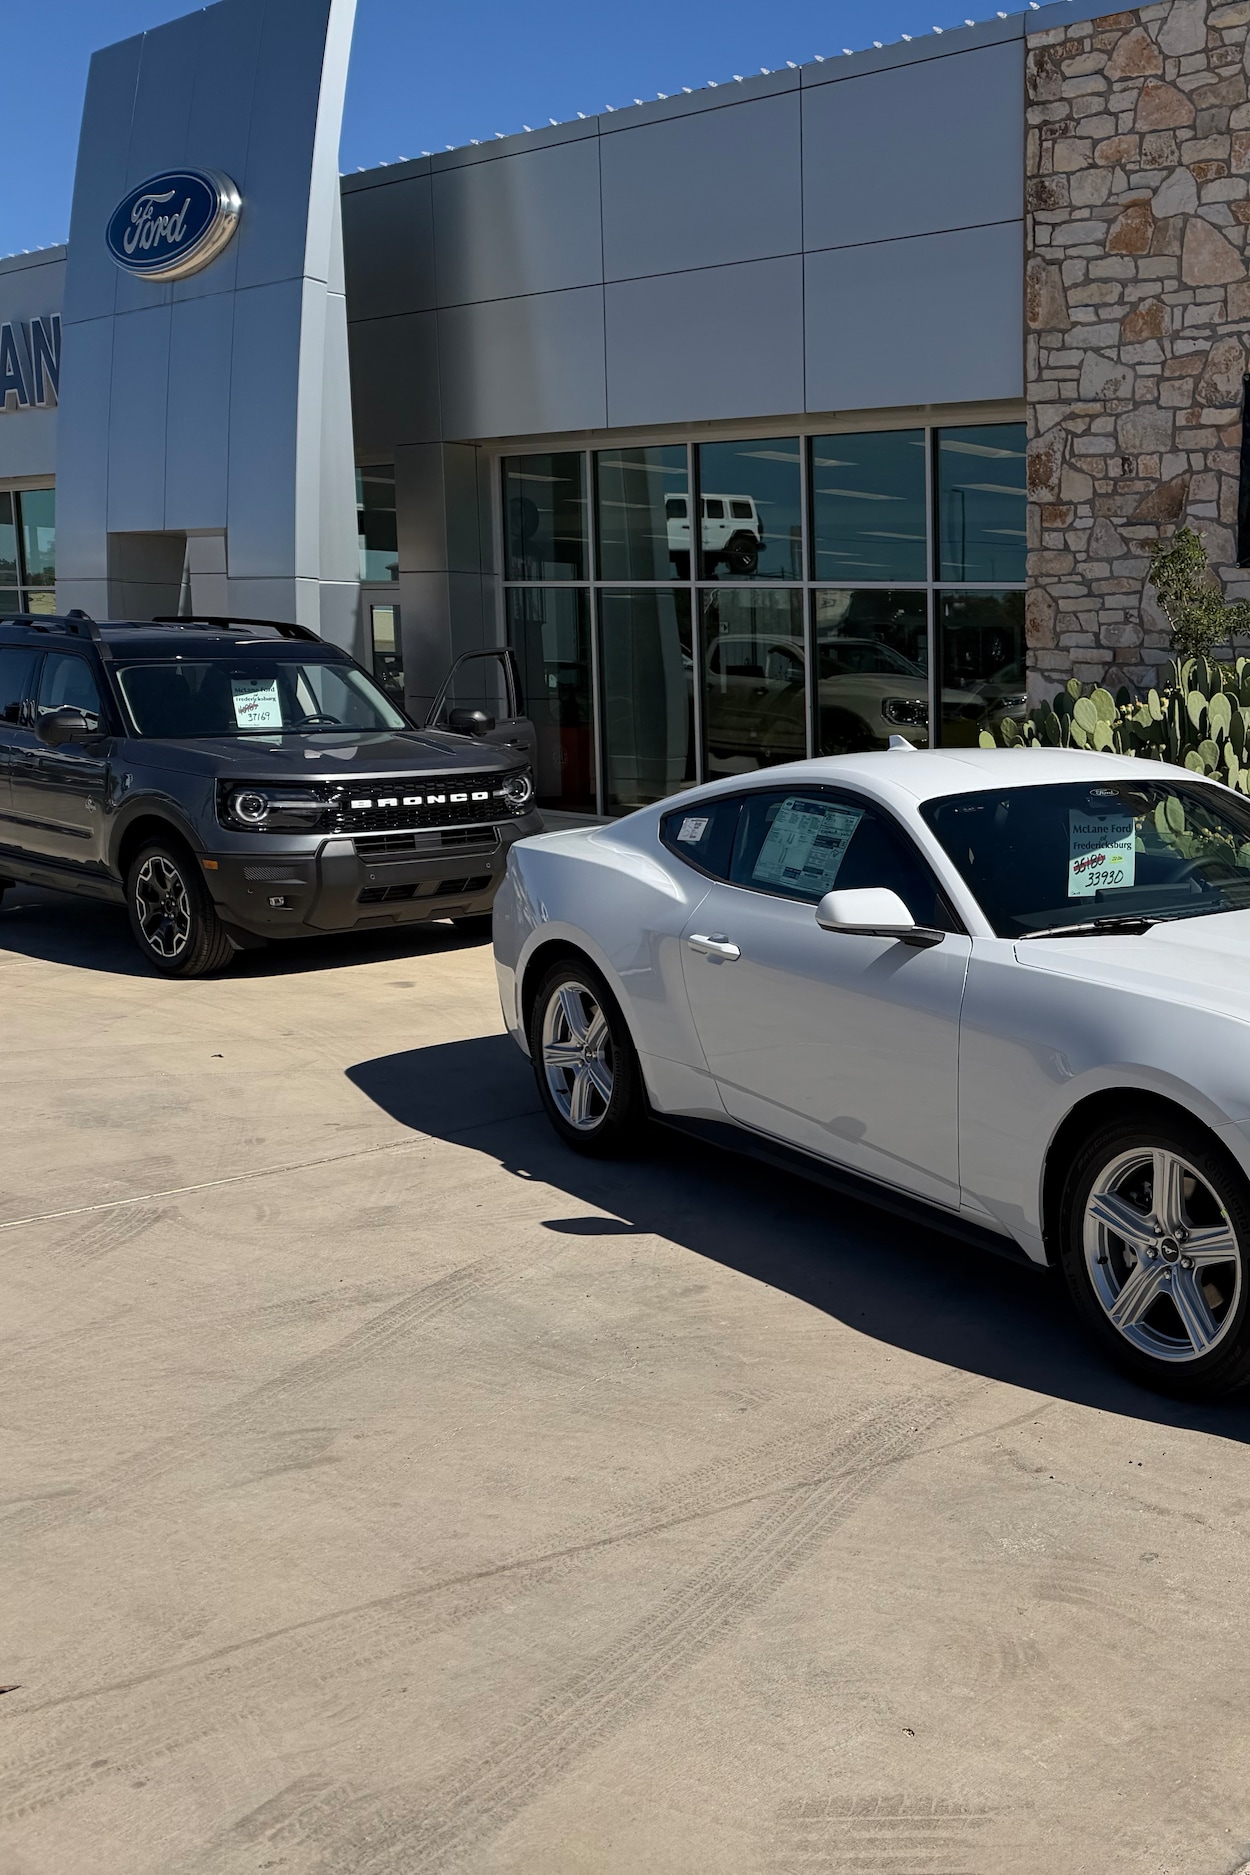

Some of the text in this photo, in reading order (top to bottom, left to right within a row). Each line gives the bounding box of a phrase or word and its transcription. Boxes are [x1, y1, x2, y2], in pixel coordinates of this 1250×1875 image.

[123, 189, 192, 255] Ford
[248, 712, 270, 721] 37169
[350, 791, 489, 809] BRONCO
[1072, 823, 1132, 834] McLane Ford
[1073, 840, 1132, 851] Fredericksburg
[1085, 869, 1124, 888] 33930
